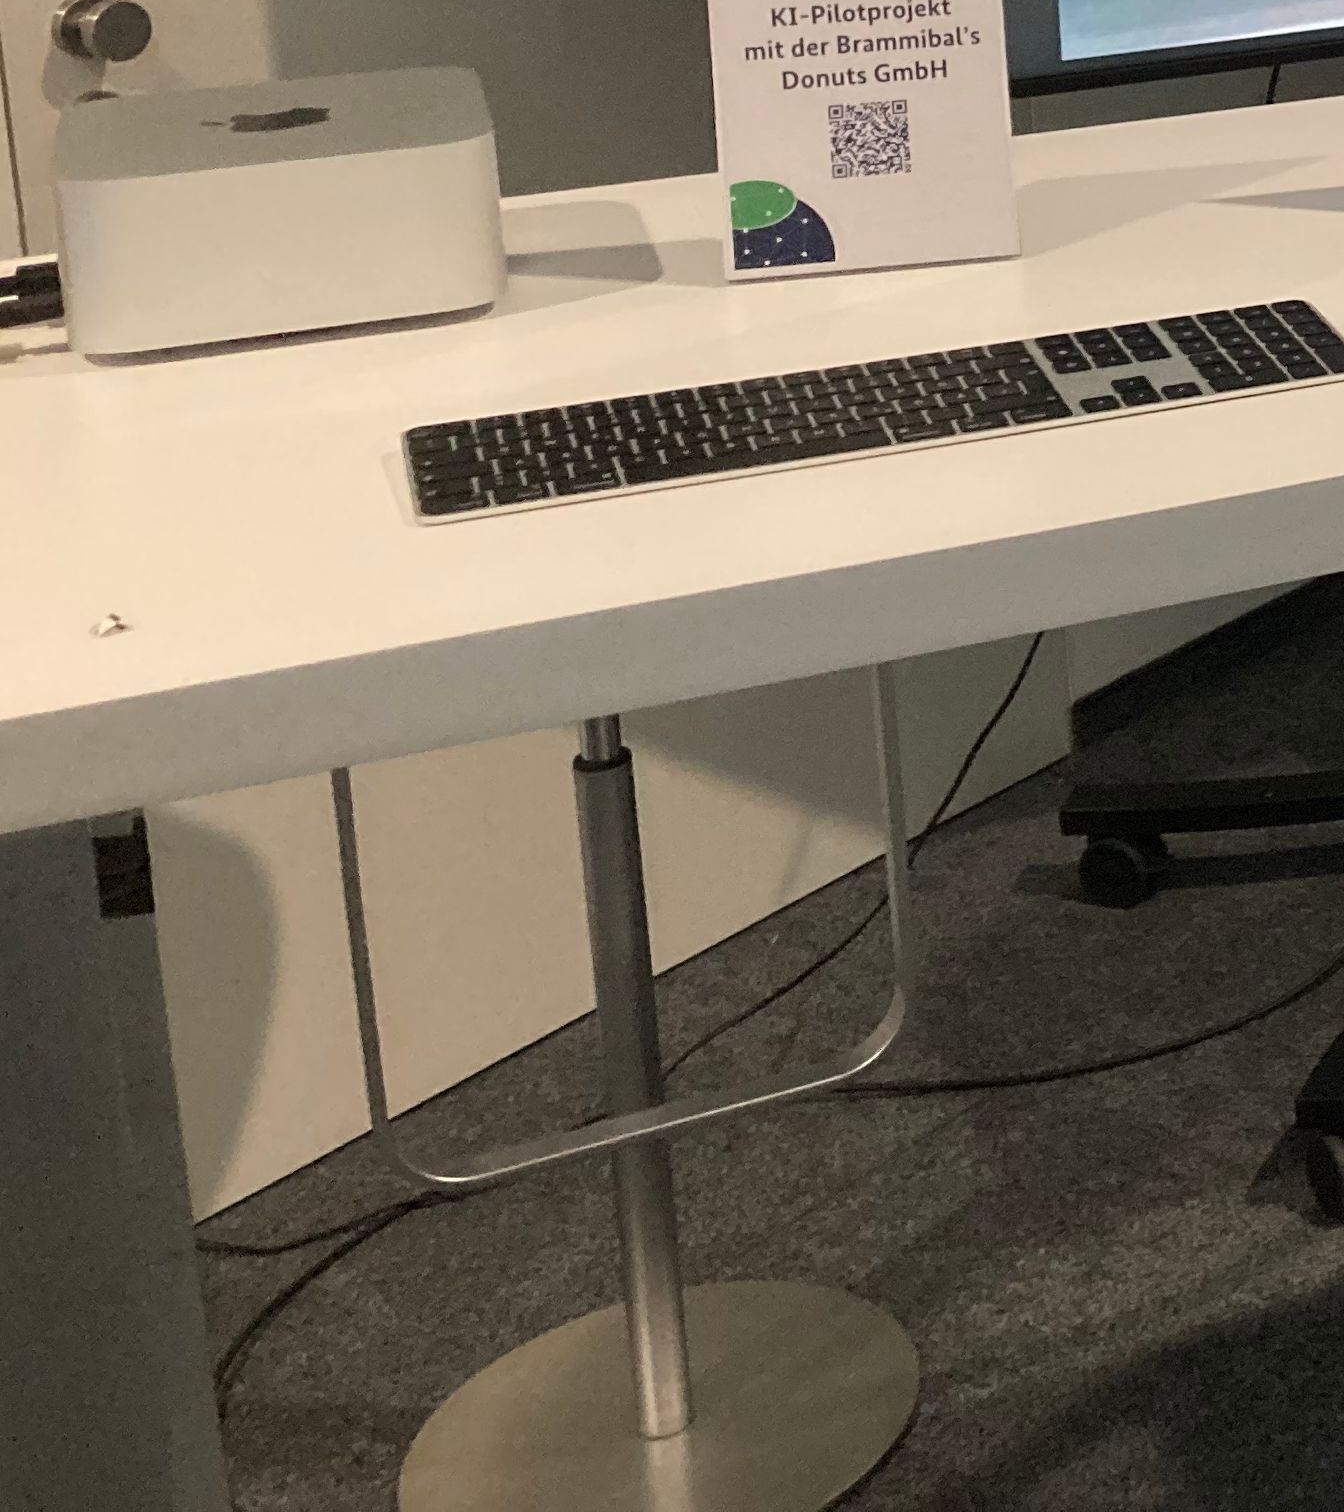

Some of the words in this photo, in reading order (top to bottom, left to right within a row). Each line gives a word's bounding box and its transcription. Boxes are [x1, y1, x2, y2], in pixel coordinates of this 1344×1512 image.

[744, 39, 785, 62] mit
[790, 37, 830, 60] der
[782, 64, 868, 91] Donuts
[873, 58, 949, 85] GmbH
